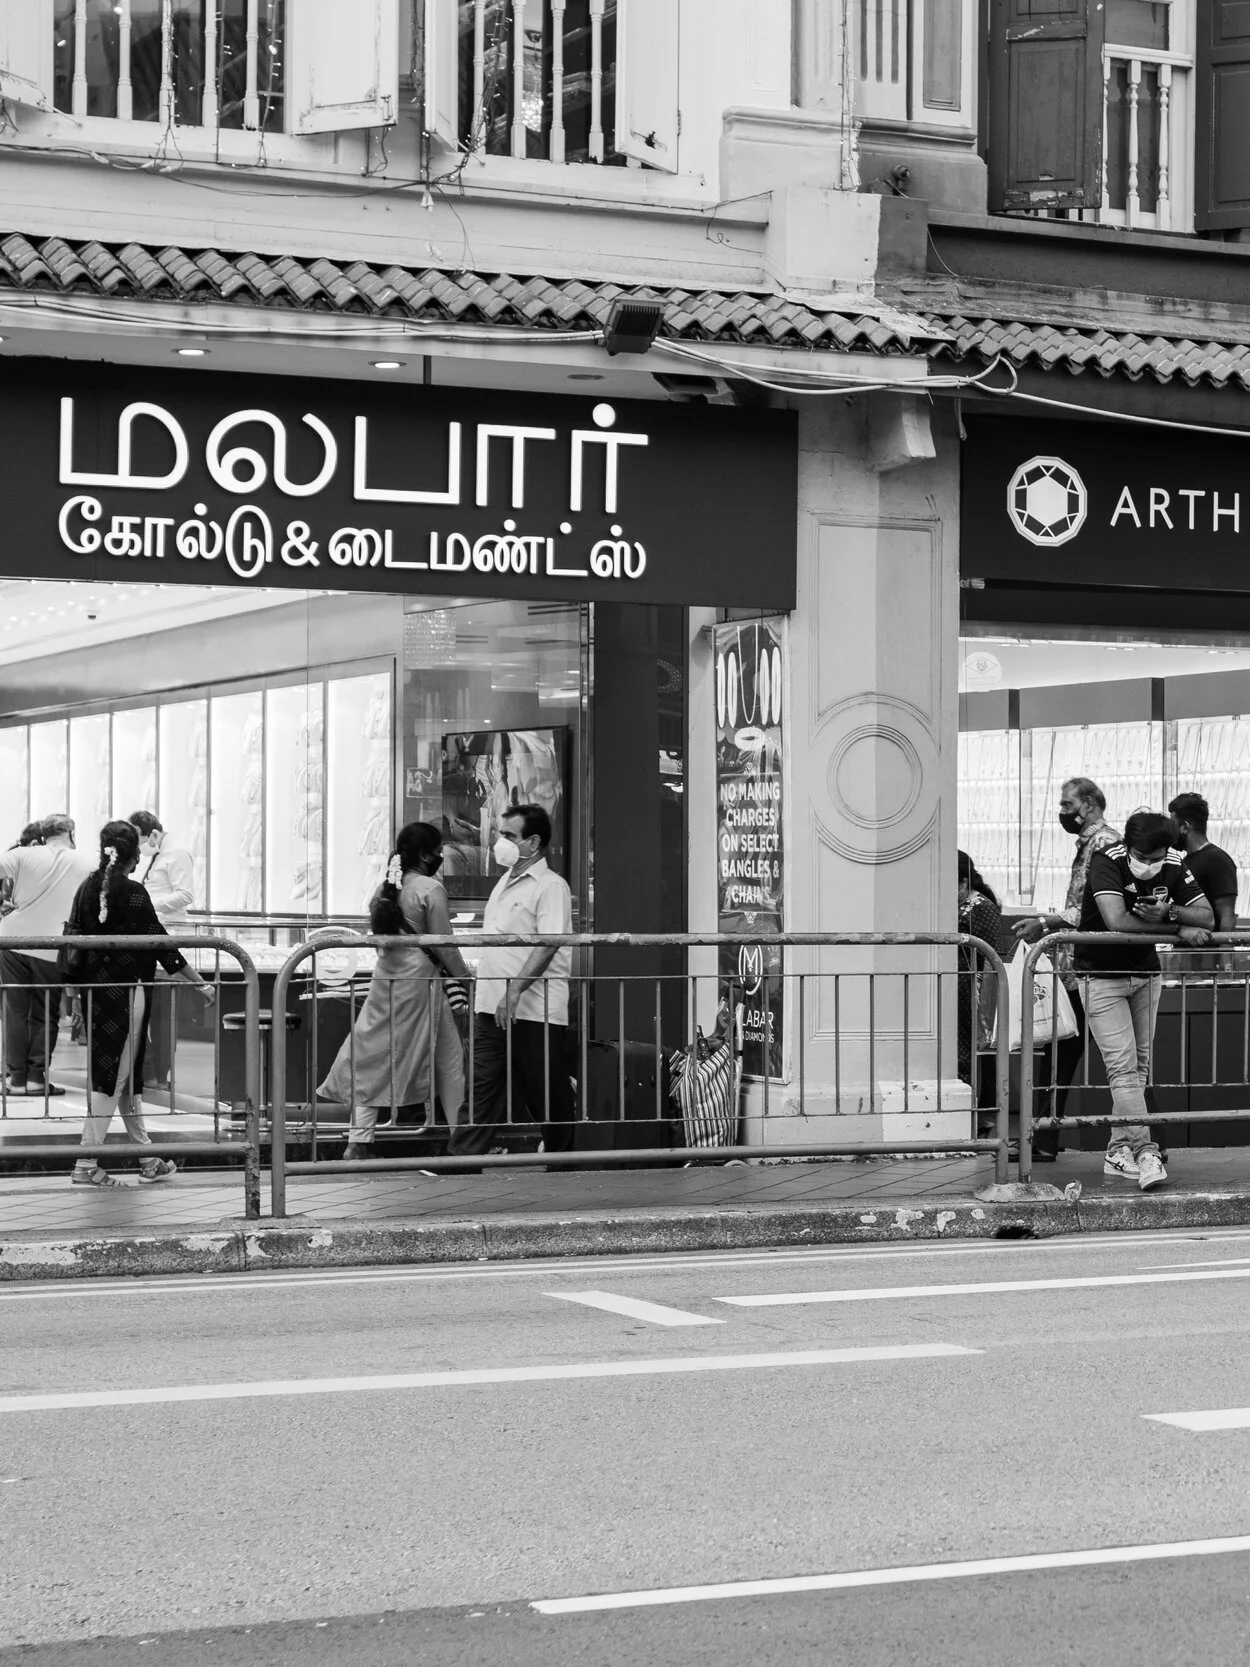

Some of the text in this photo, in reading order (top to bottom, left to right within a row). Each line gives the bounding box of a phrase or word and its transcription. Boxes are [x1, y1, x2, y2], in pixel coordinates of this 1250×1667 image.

[59, 397, 648, 513] மலபார்
[58, 495, 273, 578] கோல்டு
[720, 781, 780, 801] NO MAKING
[726, 807, 775, 827] CHARGES
[722, 833, 779, 852] ON SELECT
[722, 859, 780, 878] BANGLES &
[731, 885, 771, 904] CHAINS
